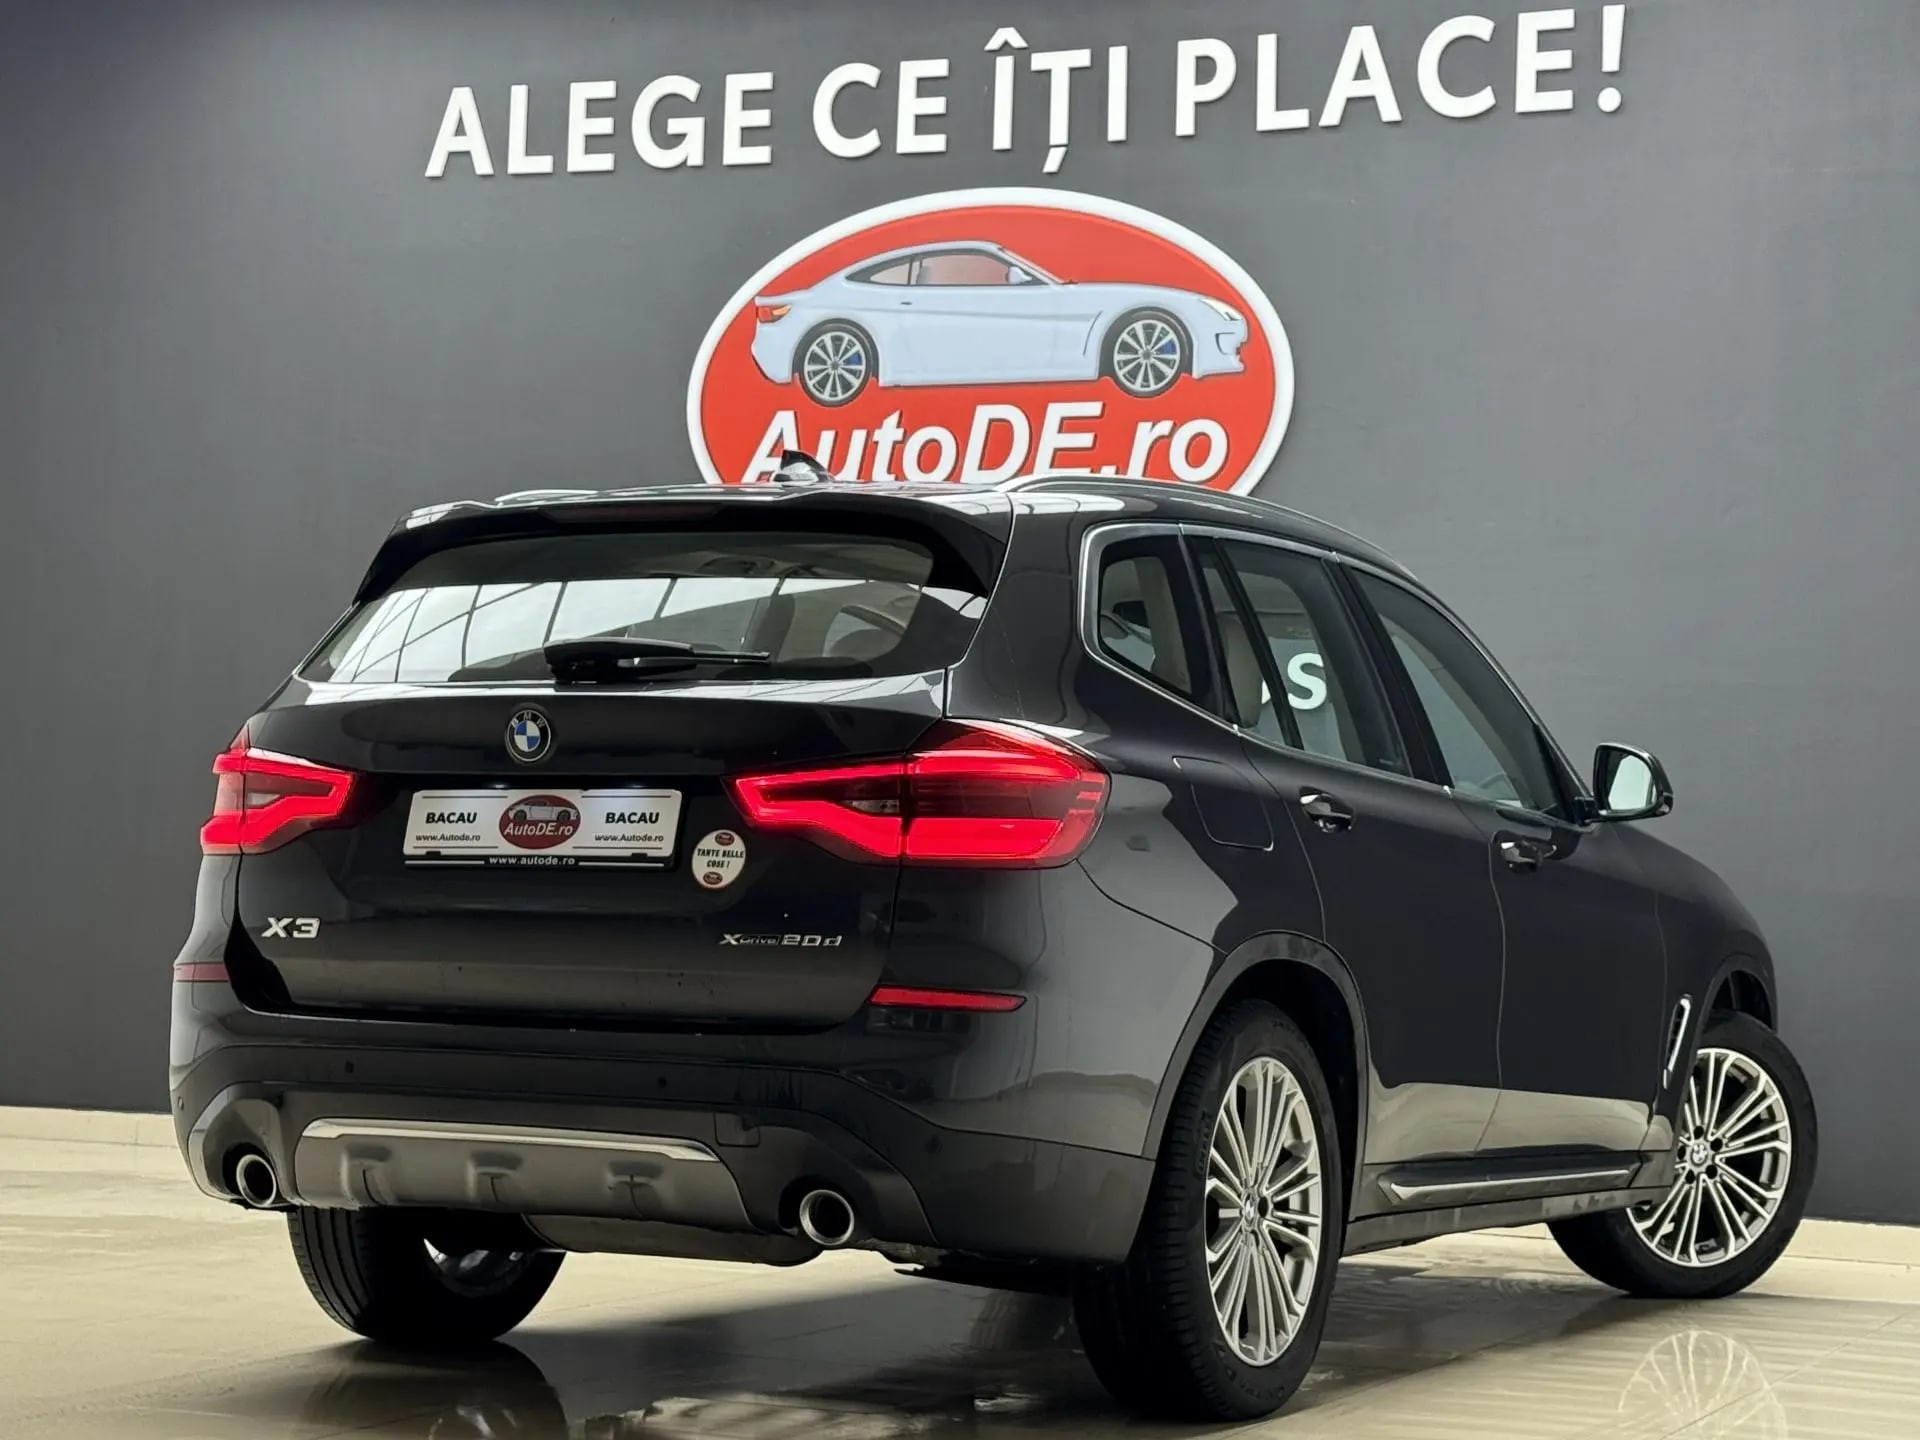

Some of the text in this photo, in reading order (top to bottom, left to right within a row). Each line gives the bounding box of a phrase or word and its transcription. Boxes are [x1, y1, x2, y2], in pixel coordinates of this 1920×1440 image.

[425, 4, 1626, 178] ALEGE CE ÎȚI PLACE!
[741, 400, 1229, 484] AutoDE.ro
[511, 710, 546, 728] BMW
[425, 812, 478, 824] BACAU
[605, 812, 660, 824] BACAU
[503, 822, 574, 836] AutoDE.ro
[415, 833, 481, 842] www.Autode.ro
[594, 833, 664, 843] www.Autode.ro
[697, 848, 744, 859] TANTE BELLE
[489, 856, 576, 865] www.autode.ro
[261, 917, 320, 938] X3
